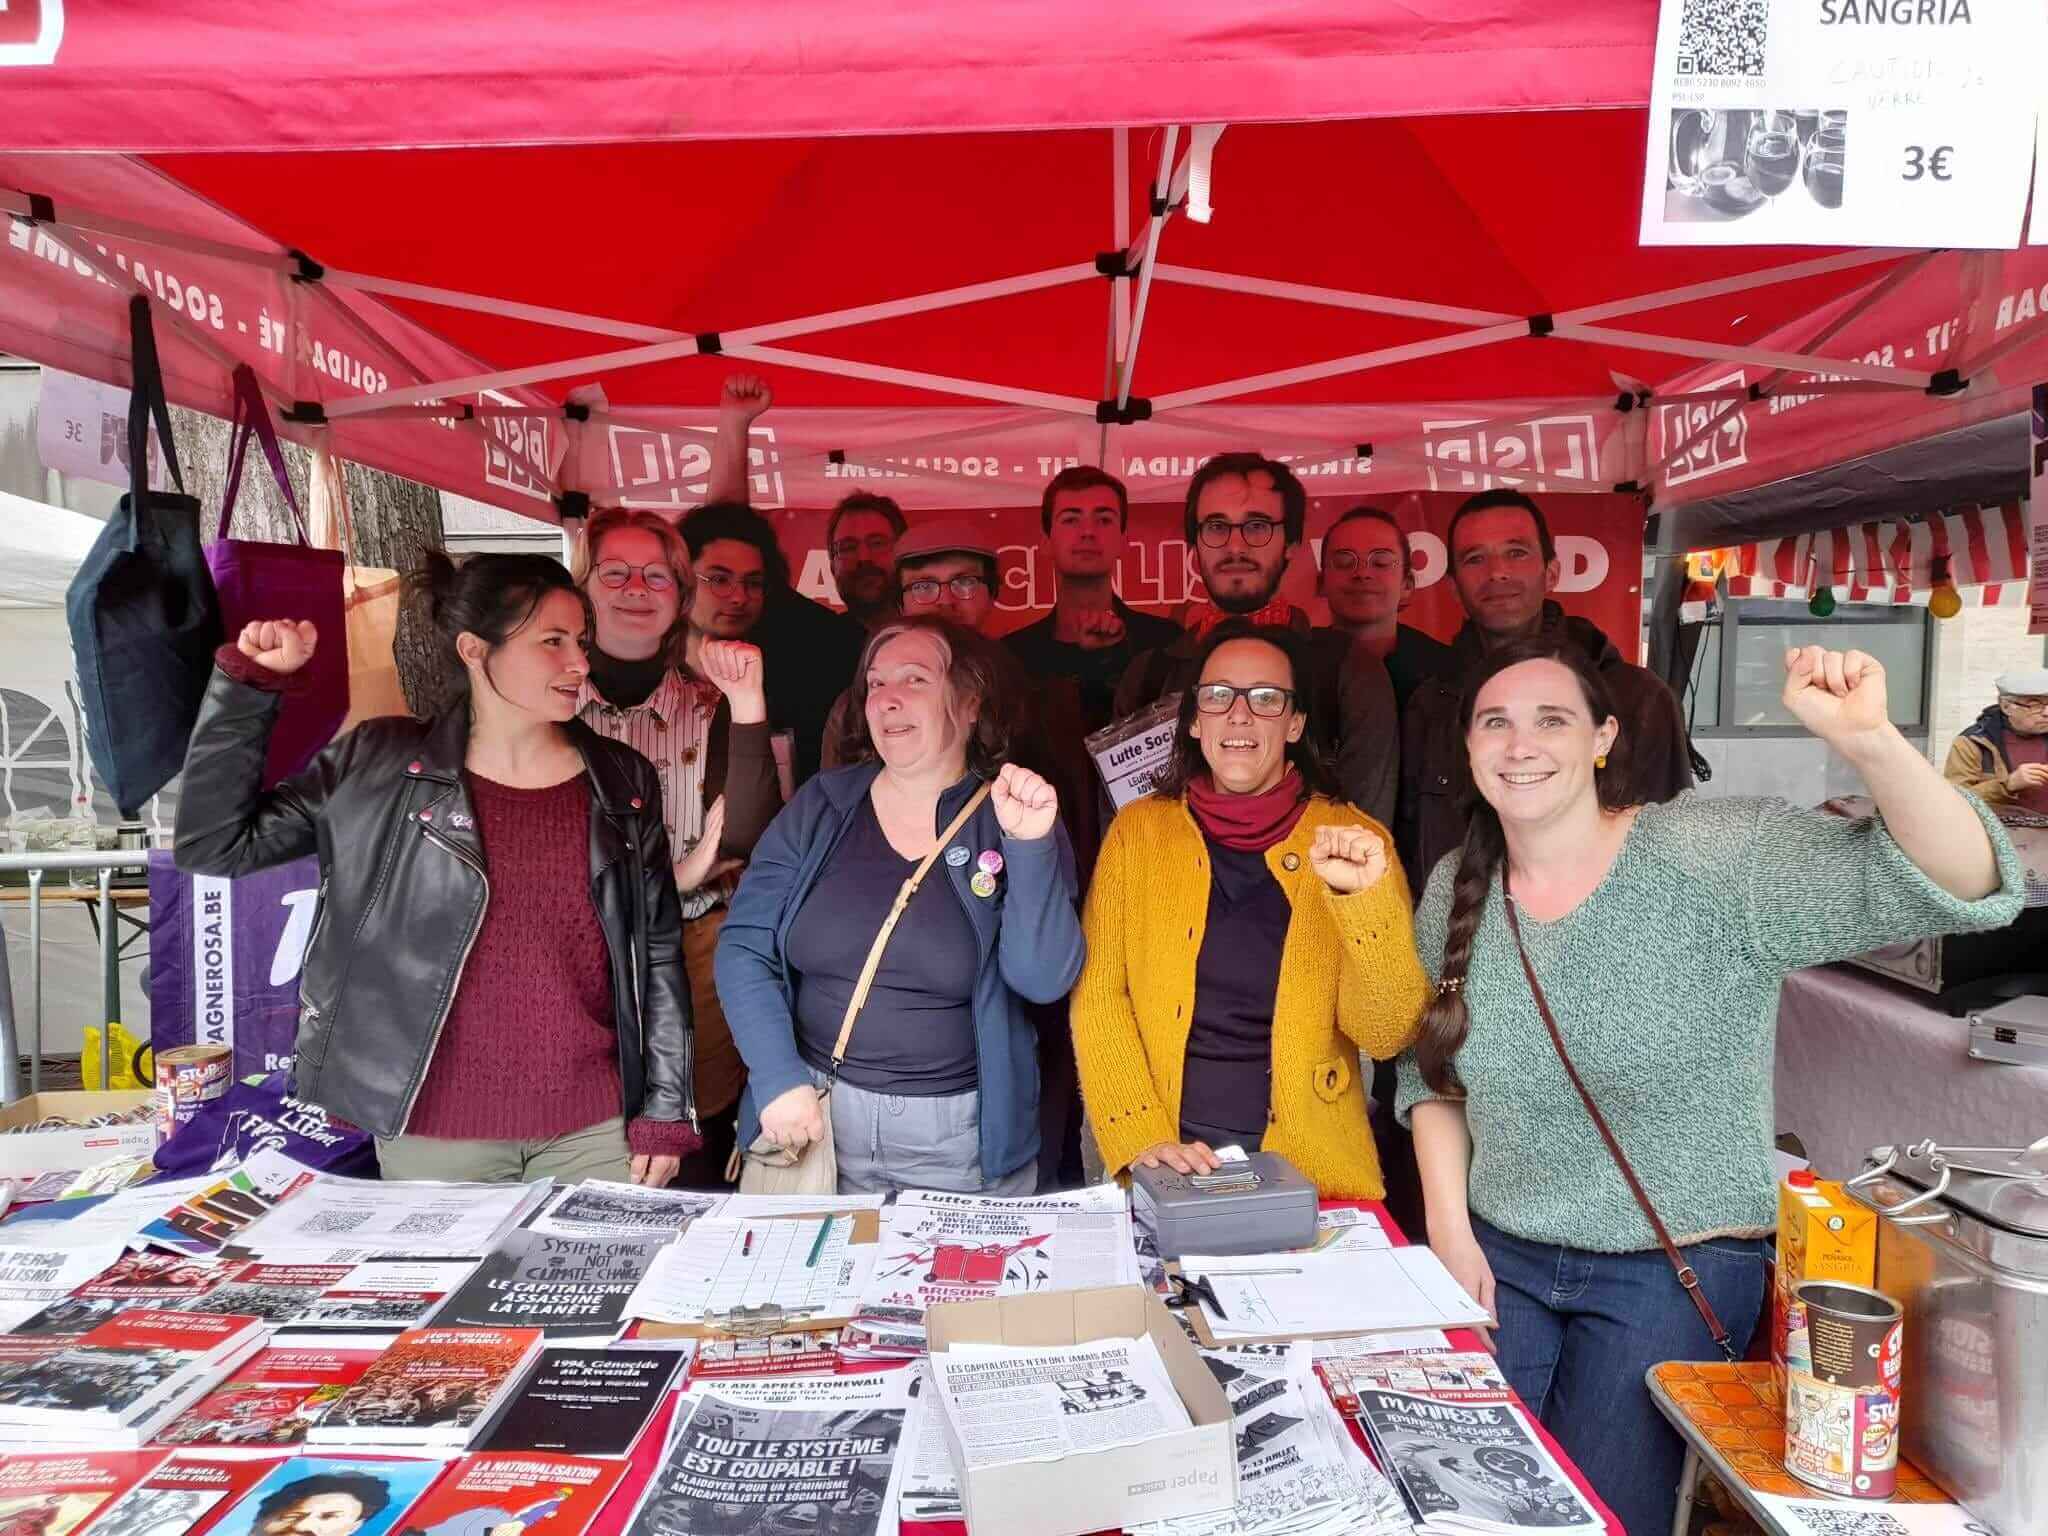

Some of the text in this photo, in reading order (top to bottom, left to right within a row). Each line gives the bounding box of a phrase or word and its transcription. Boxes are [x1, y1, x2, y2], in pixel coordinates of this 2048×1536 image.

[1819, 0, 1973, 25] SANGRIA
[1901, 145, 1954, 181] 3€
[1109, 744, 1143, 767] Lutte
[1128, 769, 1153, 788] LEURS
[205, 890, 225, 1044] AGNEROSA.BE
[920, 1193, 1082, 1209] Lutte Socialiste
[584, 1255, 613, 1268] NOT
[526, 1266, 593, 1282] CLIMATE
[487, 1277, 635, 1296] LE CAPITALISME
[918, 1285, 996, 1297] BRISONS
[501, 1291, 606, 1306] ASSASSINE
[487, 1301, 603, 1316] LA PLANÈTE
[559, 1367, 642, 1377] au Rwanda
[964, 1359, 1025, 1374] CAPITALISTES
[807, 1377, 885, 1389] STONEWALL
[694, 1432, 885, 1459] TOUT LE SYSTÈME
[473, 1461, 603, 1479] LA NATIONALISATION
[682, 1451, 858, 1480] EST COUPABLE !
[676, 1471, 850, 1493] PLAIDOYER POUR UN FÉMINISME
[670, 1482, 848, 1503] ANTICAPITALISTE ET SOCIALISTE
